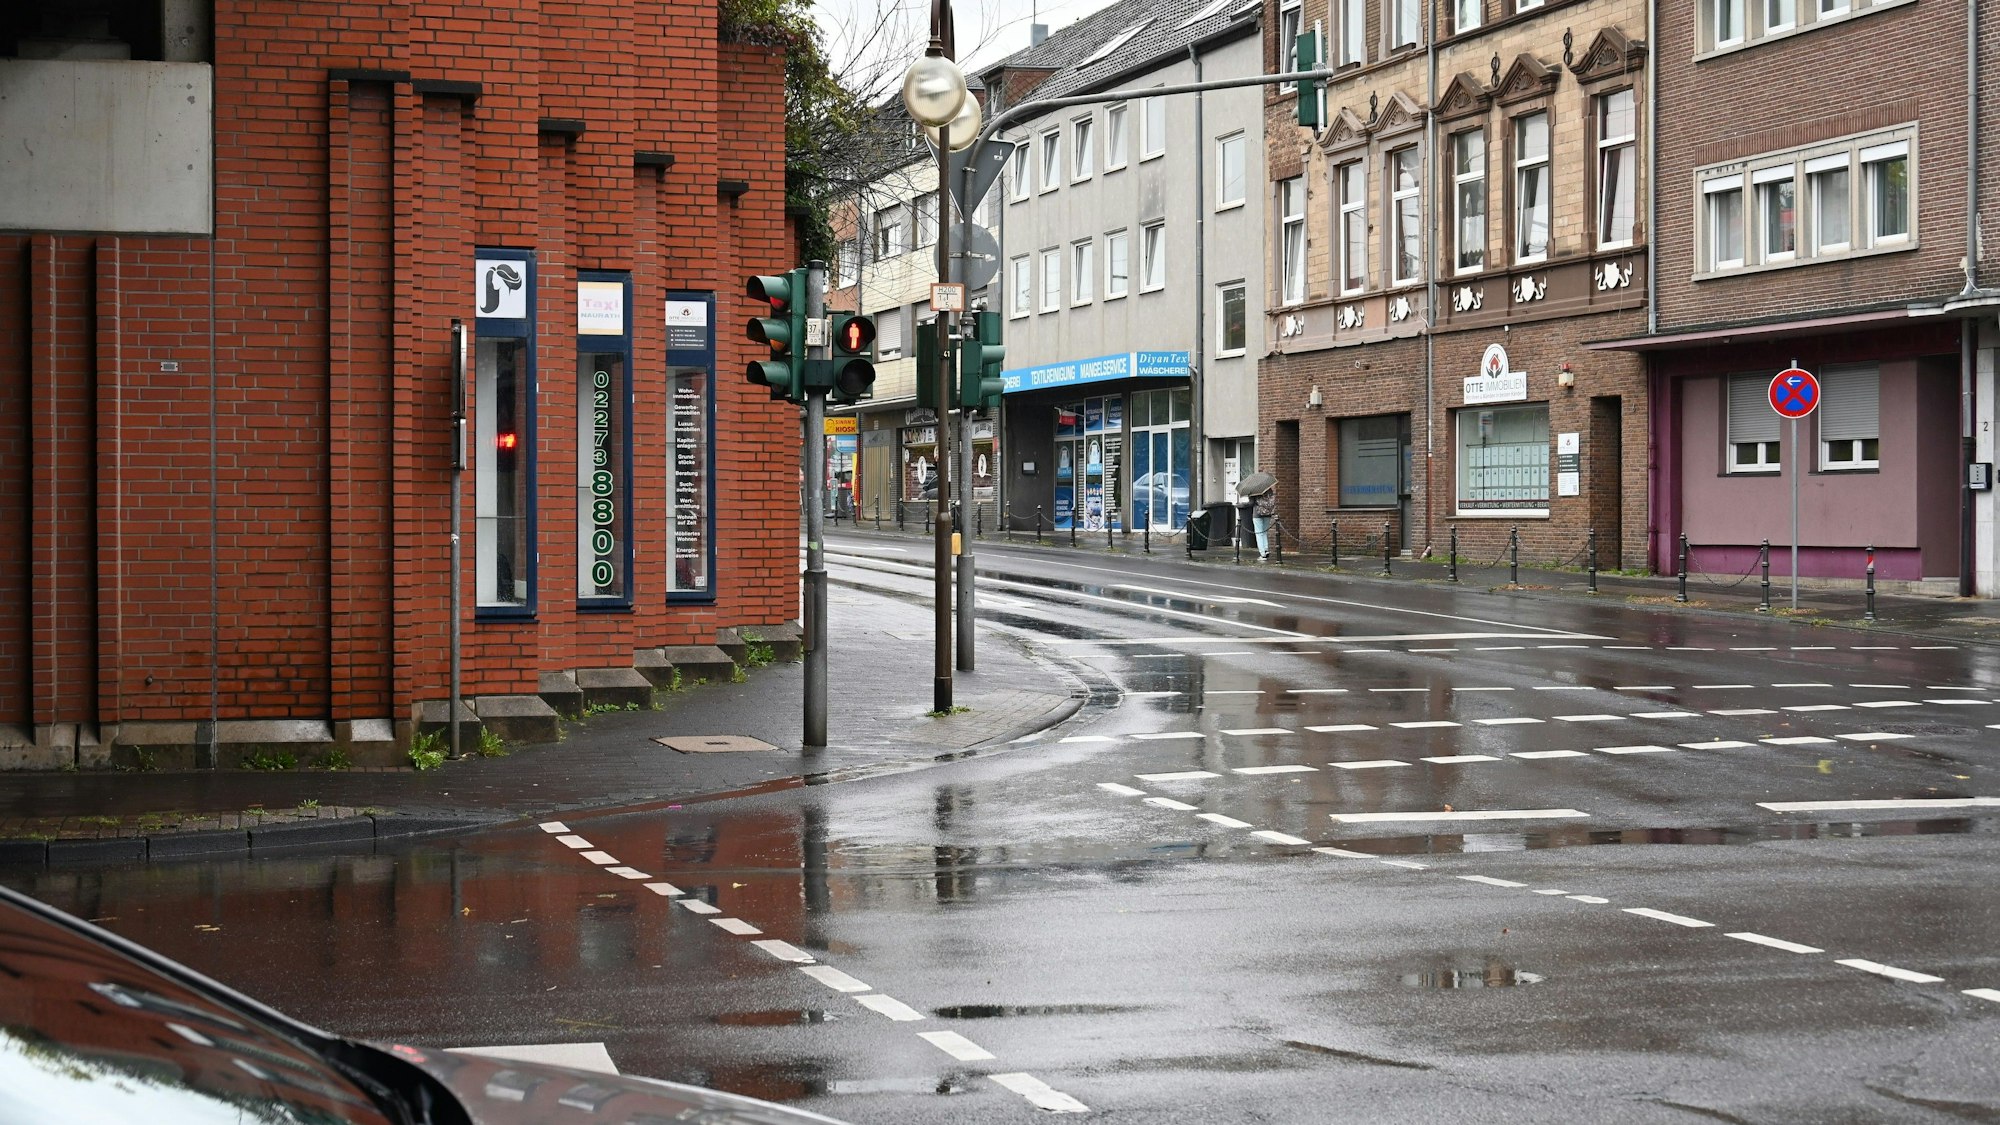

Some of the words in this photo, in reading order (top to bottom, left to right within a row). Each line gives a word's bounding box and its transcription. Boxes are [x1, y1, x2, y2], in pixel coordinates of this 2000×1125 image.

[583, 298, 618, 310] Taxi
[808, 324, 816, 334] 37
[1140, 354, 1187, 364] DiyanTex
[1031, 366, 1076, 385] TEXTILREINIGUNG
[1080, 358, 1126, 379] MANGELSERVICE
[1139, 366, 1188, 374] WÄSCHEREI
[1466, 383, 1483, 393] OTTE
[1486, 378, 1524, 391] IMMOBILIEN
[1984, 422, 1988, 432] 2
